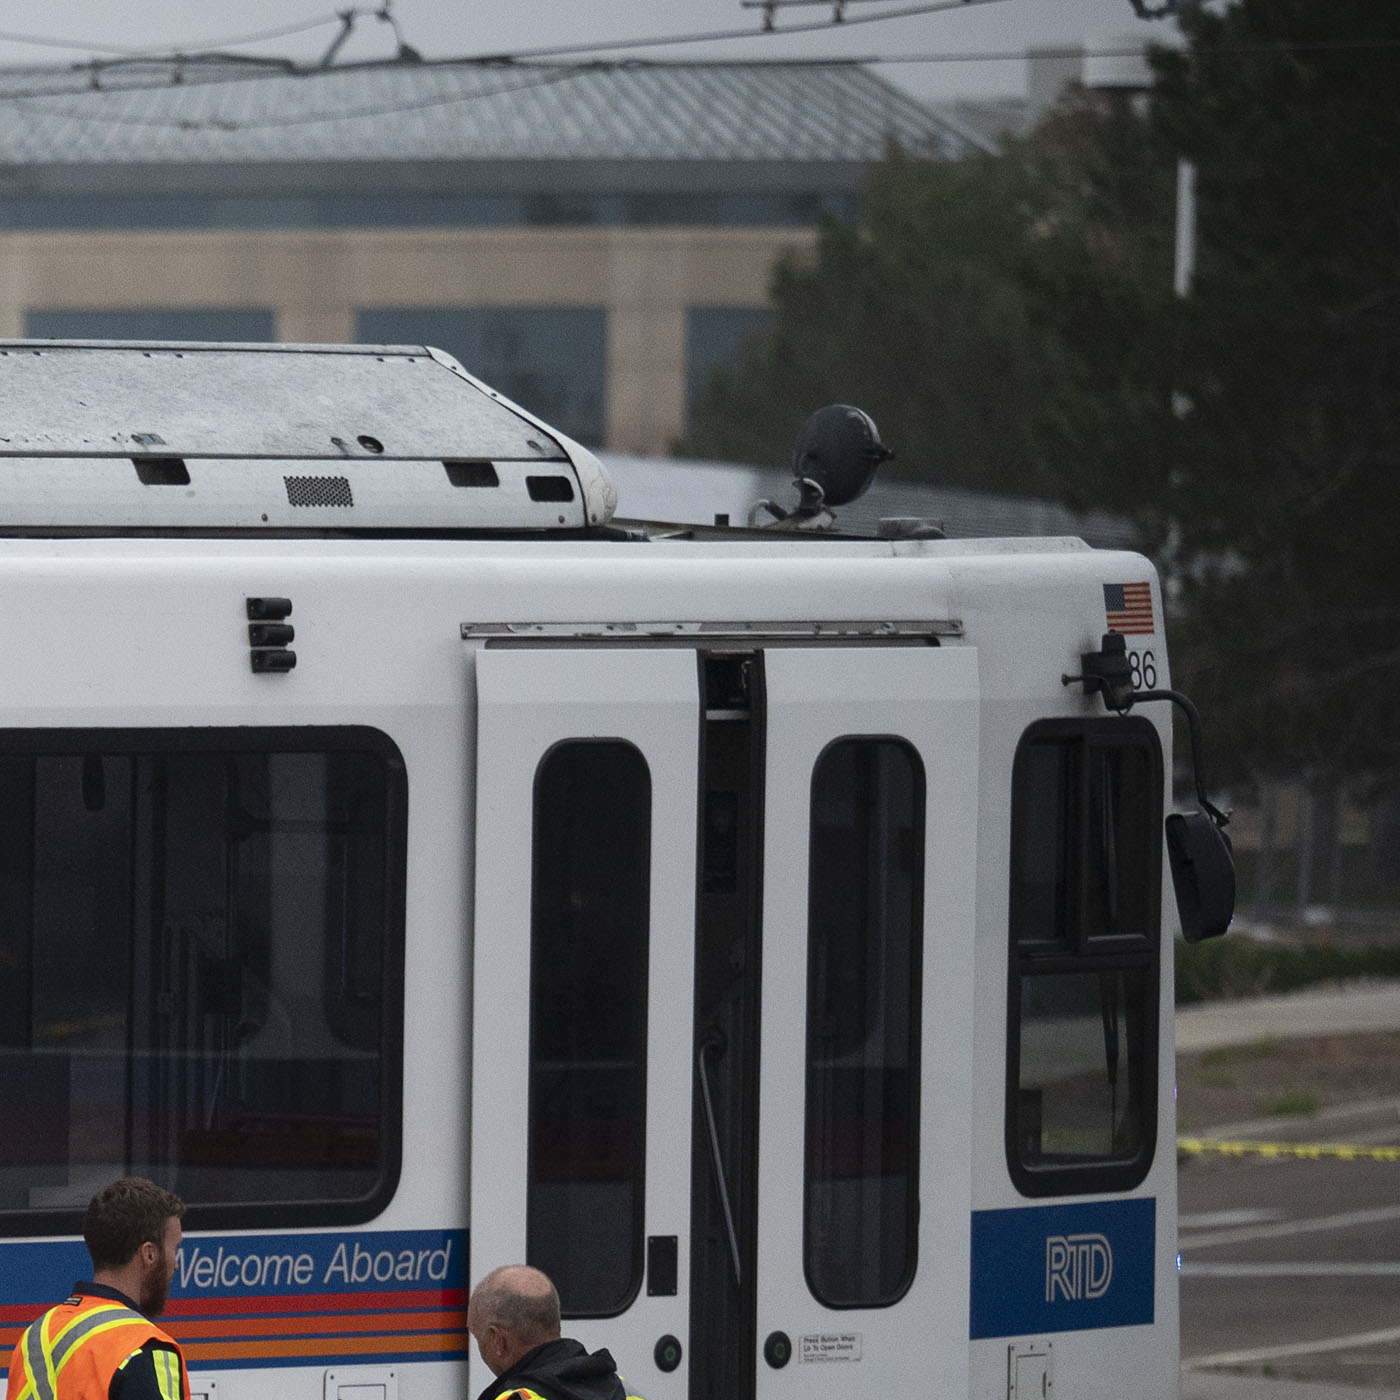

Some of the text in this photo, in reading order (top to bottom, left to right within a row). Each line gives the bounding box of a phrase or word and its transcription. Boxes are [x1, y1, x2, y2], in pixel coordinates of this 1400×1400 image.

[1128, 651, 1156, 689] 86
[176, 1239, 453, 1289] Welcome Aboard
[1045, 1233, 1113, 1302] RTD
